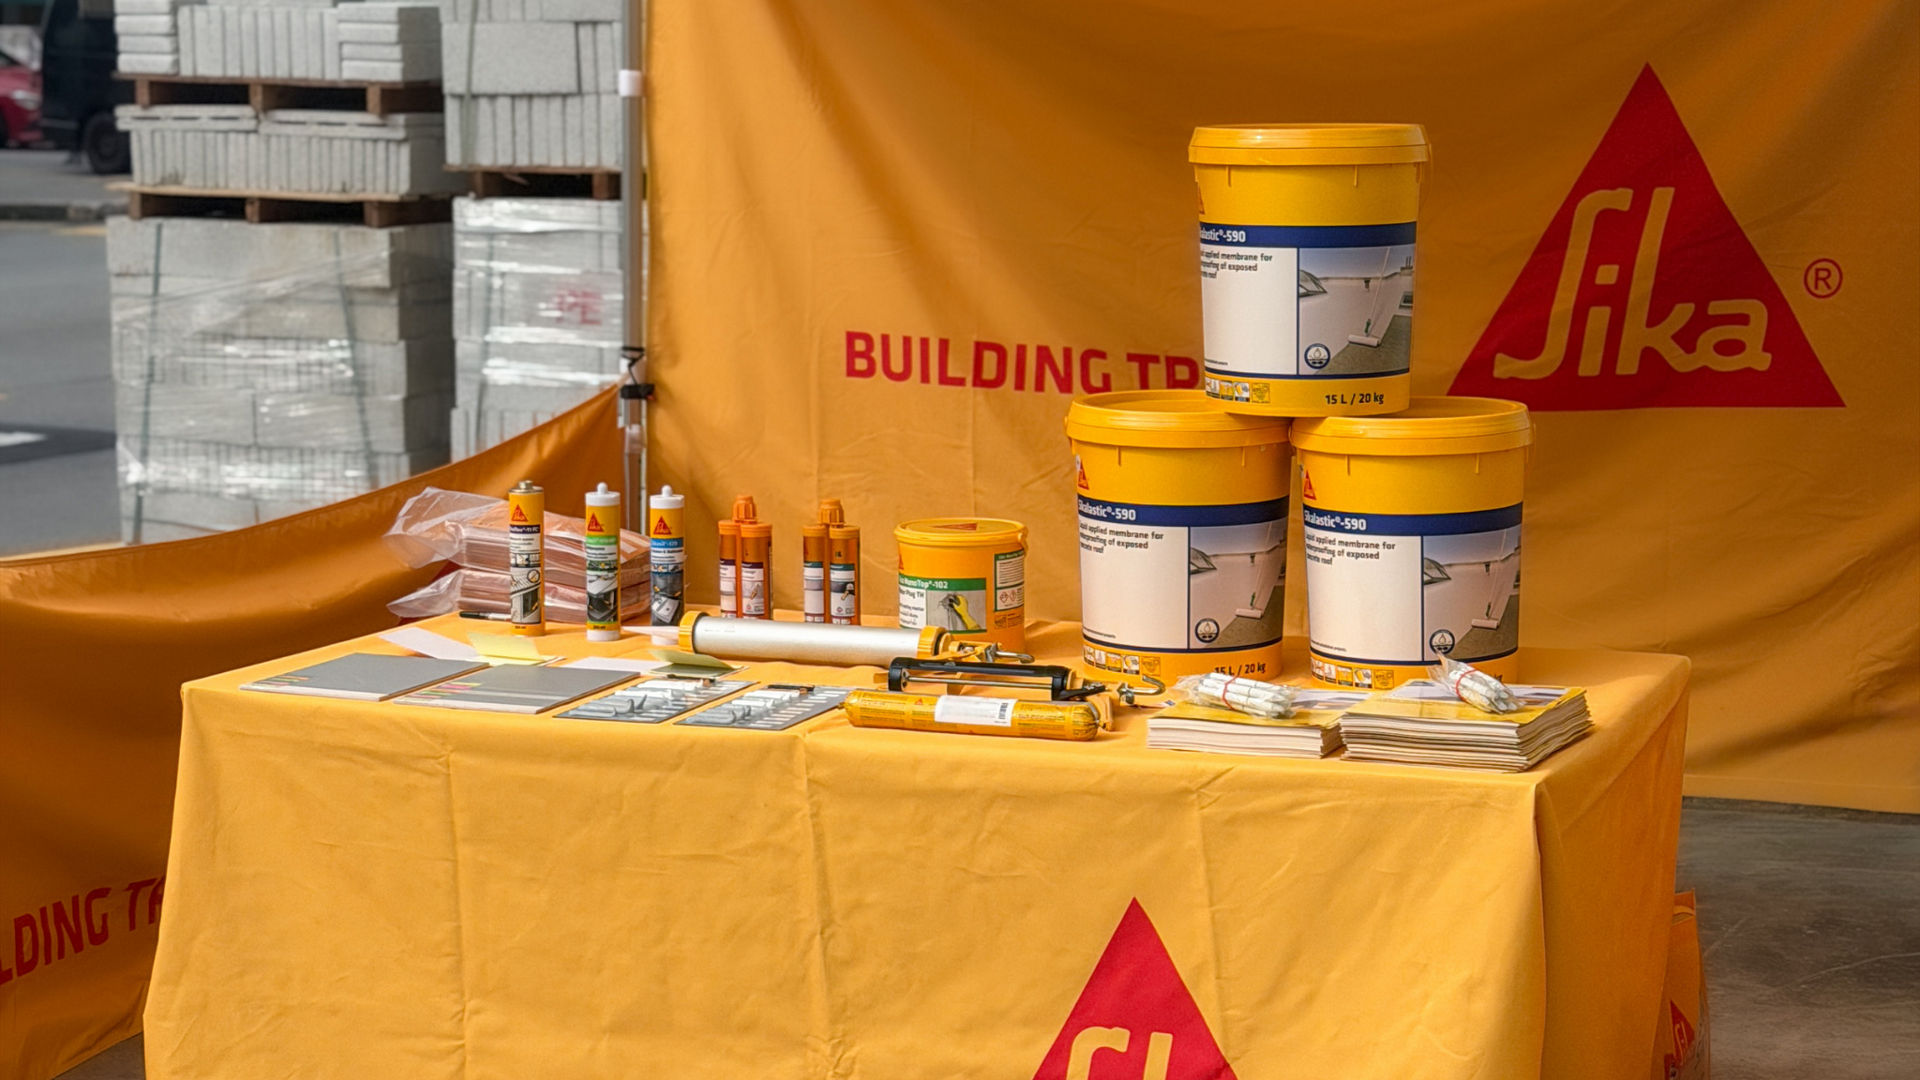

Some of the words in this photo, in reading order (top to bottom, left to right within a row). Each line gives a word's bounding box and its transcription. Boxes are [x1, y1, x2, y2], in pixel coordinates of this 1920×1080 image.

[1221, 252, 1258, 261] membrane
[1260, 253, 1273, 262] for
[1228, 263, 1258, 272] exposed
[1493, 186, 1773, 380] Sika
[845, 330, 1112, 395] BUILDING
[1325, 394, 1338, 404] 15
[1341, 393, 1347, 404] L
[1358, 393, 1371, 403] 20
[1373, 392, 1384, 405] kg
[1109, 529, 1149, 539] membrane
[1151, 531, 1164, 540] for
[1117, 540, 1149, 550] exposed
[1316, 536, 1336, 546] applied
[1338, 540, 1380, 549] membrane
[1382, 541, 1396, 550] for
[1346, 551, 1380, 560] exposed
[1244, 663, 1256, 674] 20
[1257, 662, 1266, 674] kg
